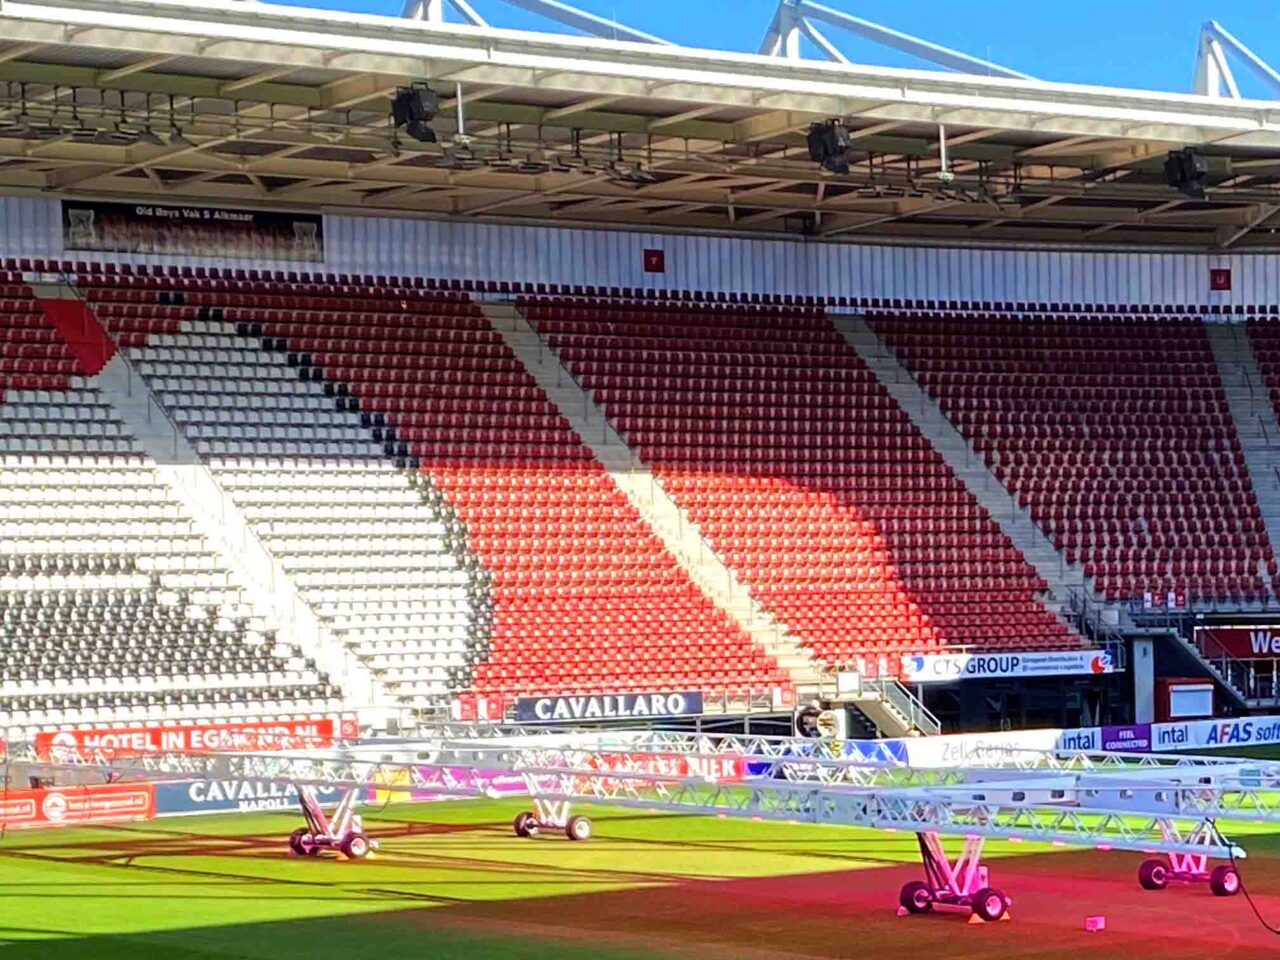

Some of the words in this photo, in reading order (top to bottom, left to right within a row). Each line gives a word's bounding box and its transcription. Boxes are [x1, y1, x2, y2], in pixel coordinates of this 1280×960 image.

[136, 207, 153, 216] Old
[182, 209, 201, 218] Vak
[933, 658, 961, 675] CTS
[966, 657, 1020, 675] GROUP
[534, 693, 687, 720] CAVALLARO
[84, 731, 156, 753] HOTEL
[161, 730, 184, 750] IN
[1157, 724, 1189, 745] intal
[1206, 721, 1251, 745] AFAS
[240, 797, 290, 811] NAPOLI
